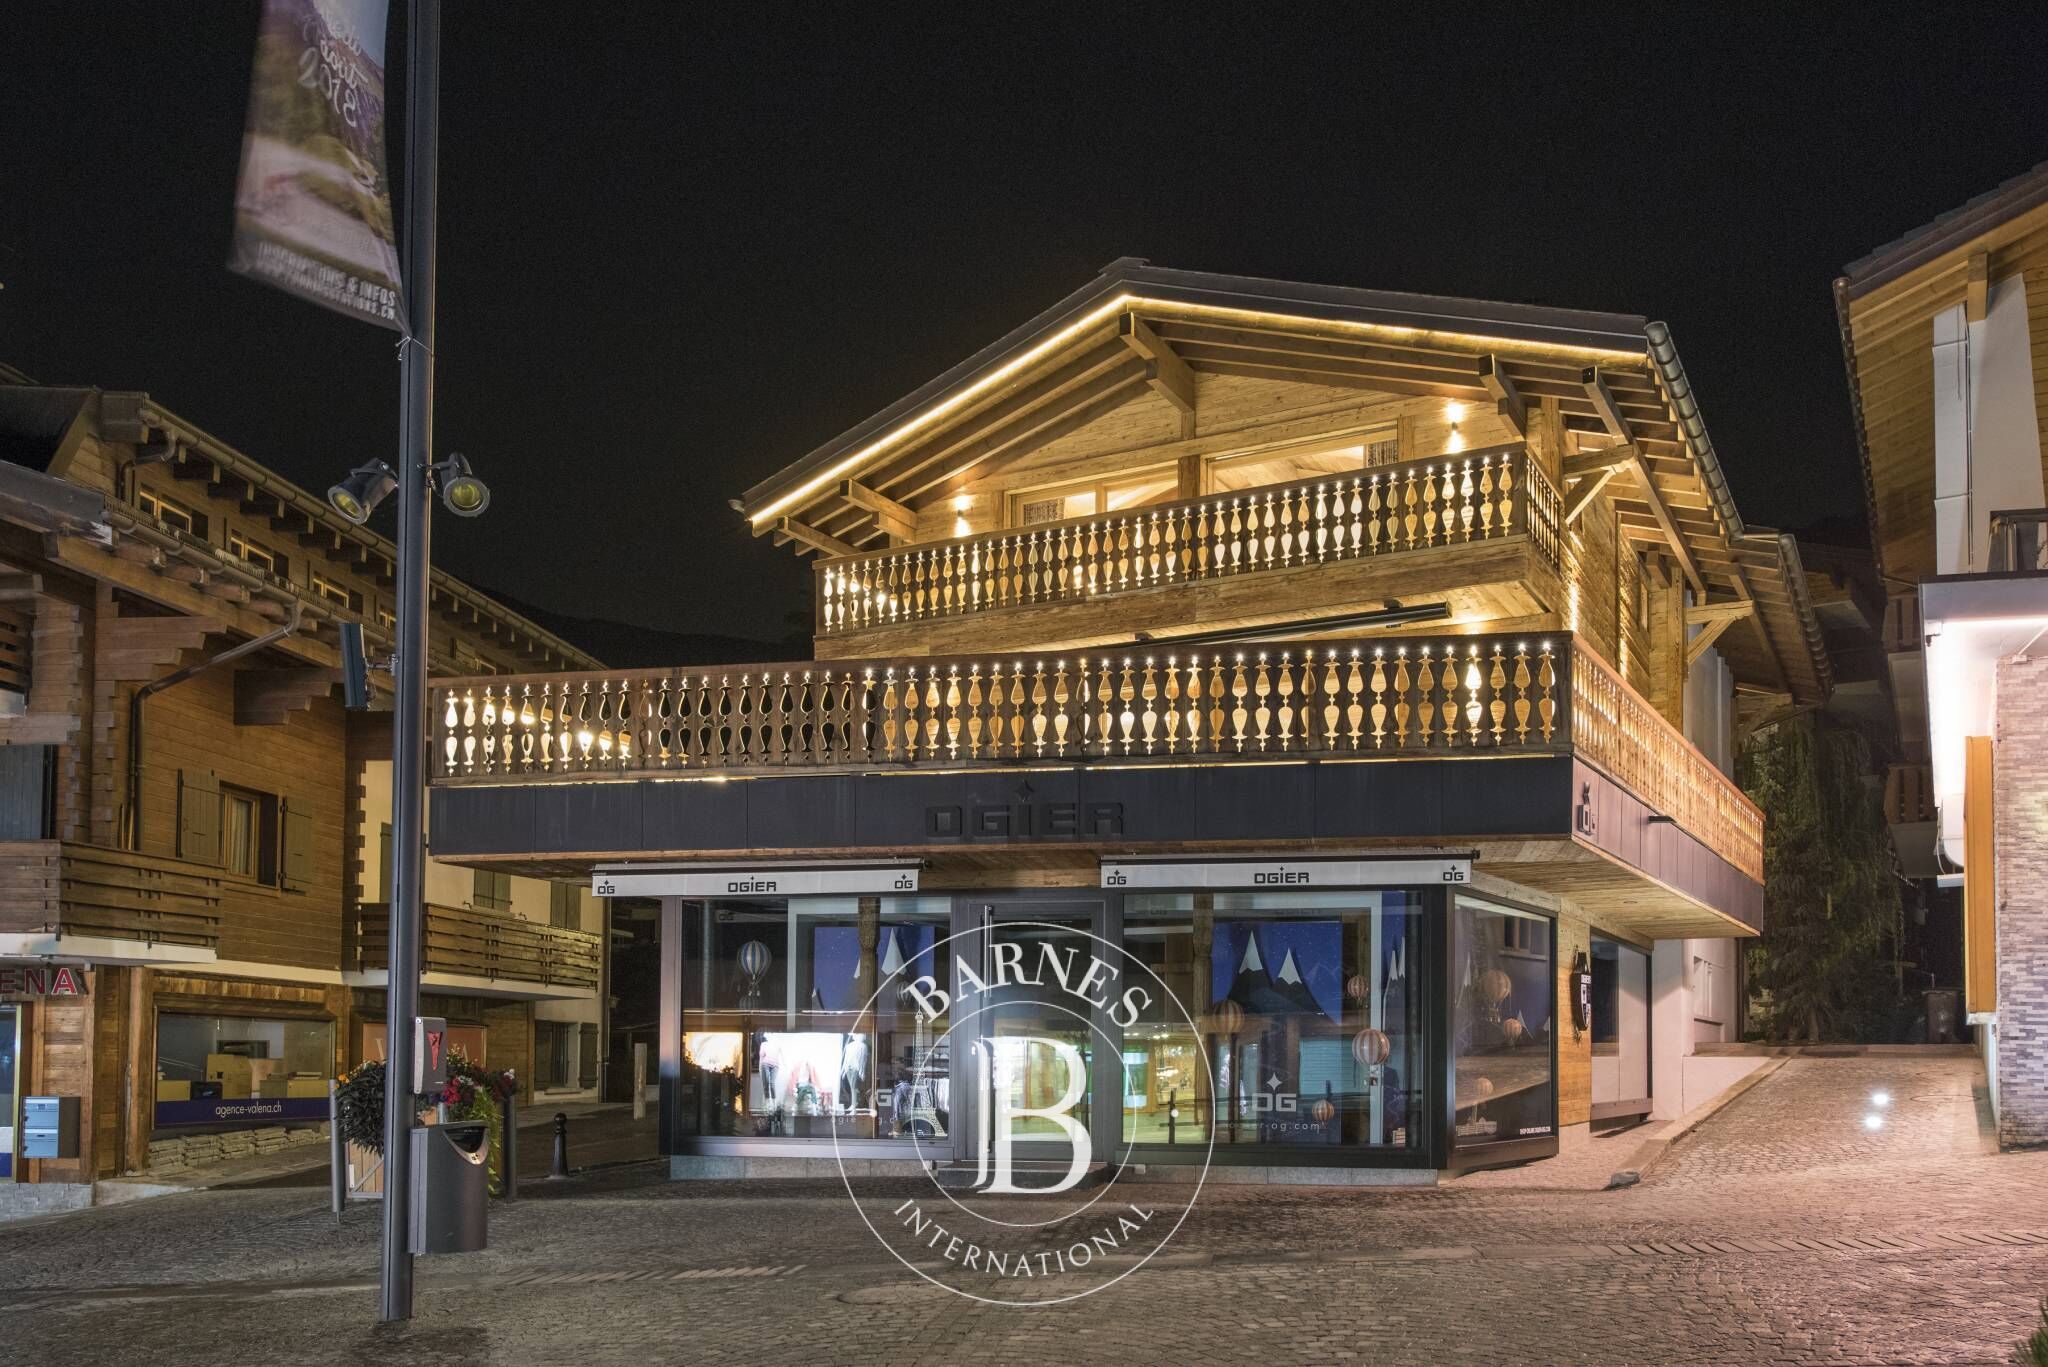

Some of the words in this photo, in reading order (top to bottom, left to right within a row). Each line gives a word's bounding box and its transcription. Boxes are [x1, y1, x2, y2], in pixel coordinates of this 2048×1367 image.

[360, 279, 396, 307] INFOS
[926, 779, 1124, 838] OGIER
[1106, 875, 1127, 885] OG
[1254, 867, 1310, 884] OGIER
[1442, 871, 1464, 881] OG
[597, 885, 615, 895] OG
[727, 877, 777, 893] OGIER
[894, 879, 913, 889] OG
[215, 1100, 282, 1118] agence-valena.ch
[1251, 1093, 1297, 1112] OG
